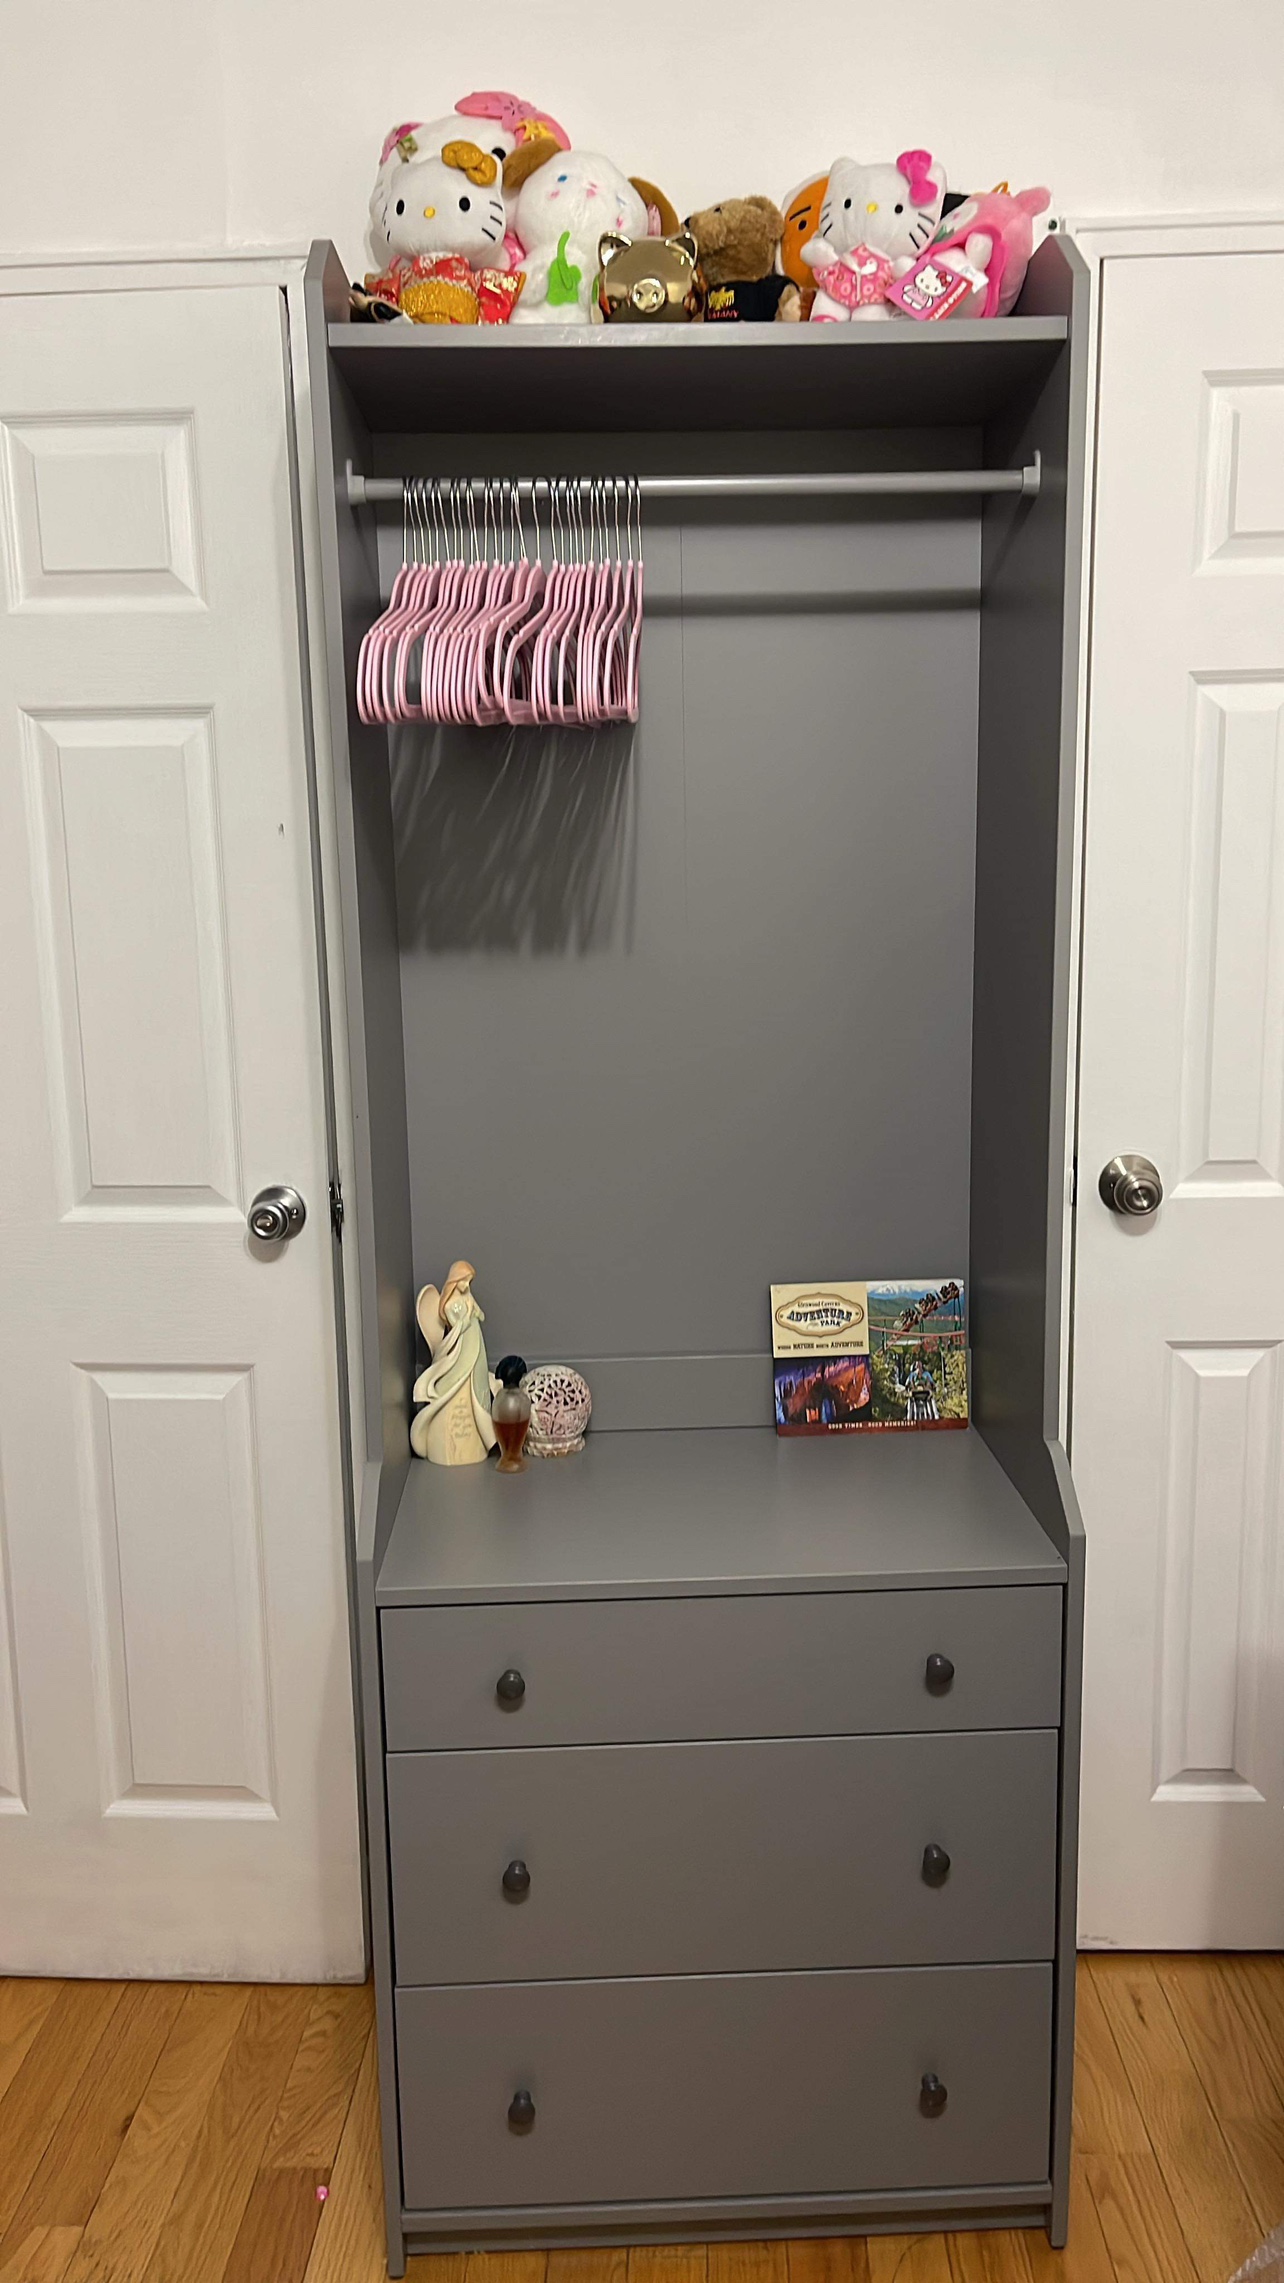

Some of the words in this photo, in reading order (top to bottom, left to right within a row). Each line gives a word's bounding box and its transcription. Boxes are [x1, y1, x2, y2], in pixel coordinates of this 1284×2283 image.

[786, 1308, 853, 1323] ADVENTURE
[793, 1342, 815, 1350] NATURE
[830, 1340, 864, 1349] ADVENTURE
